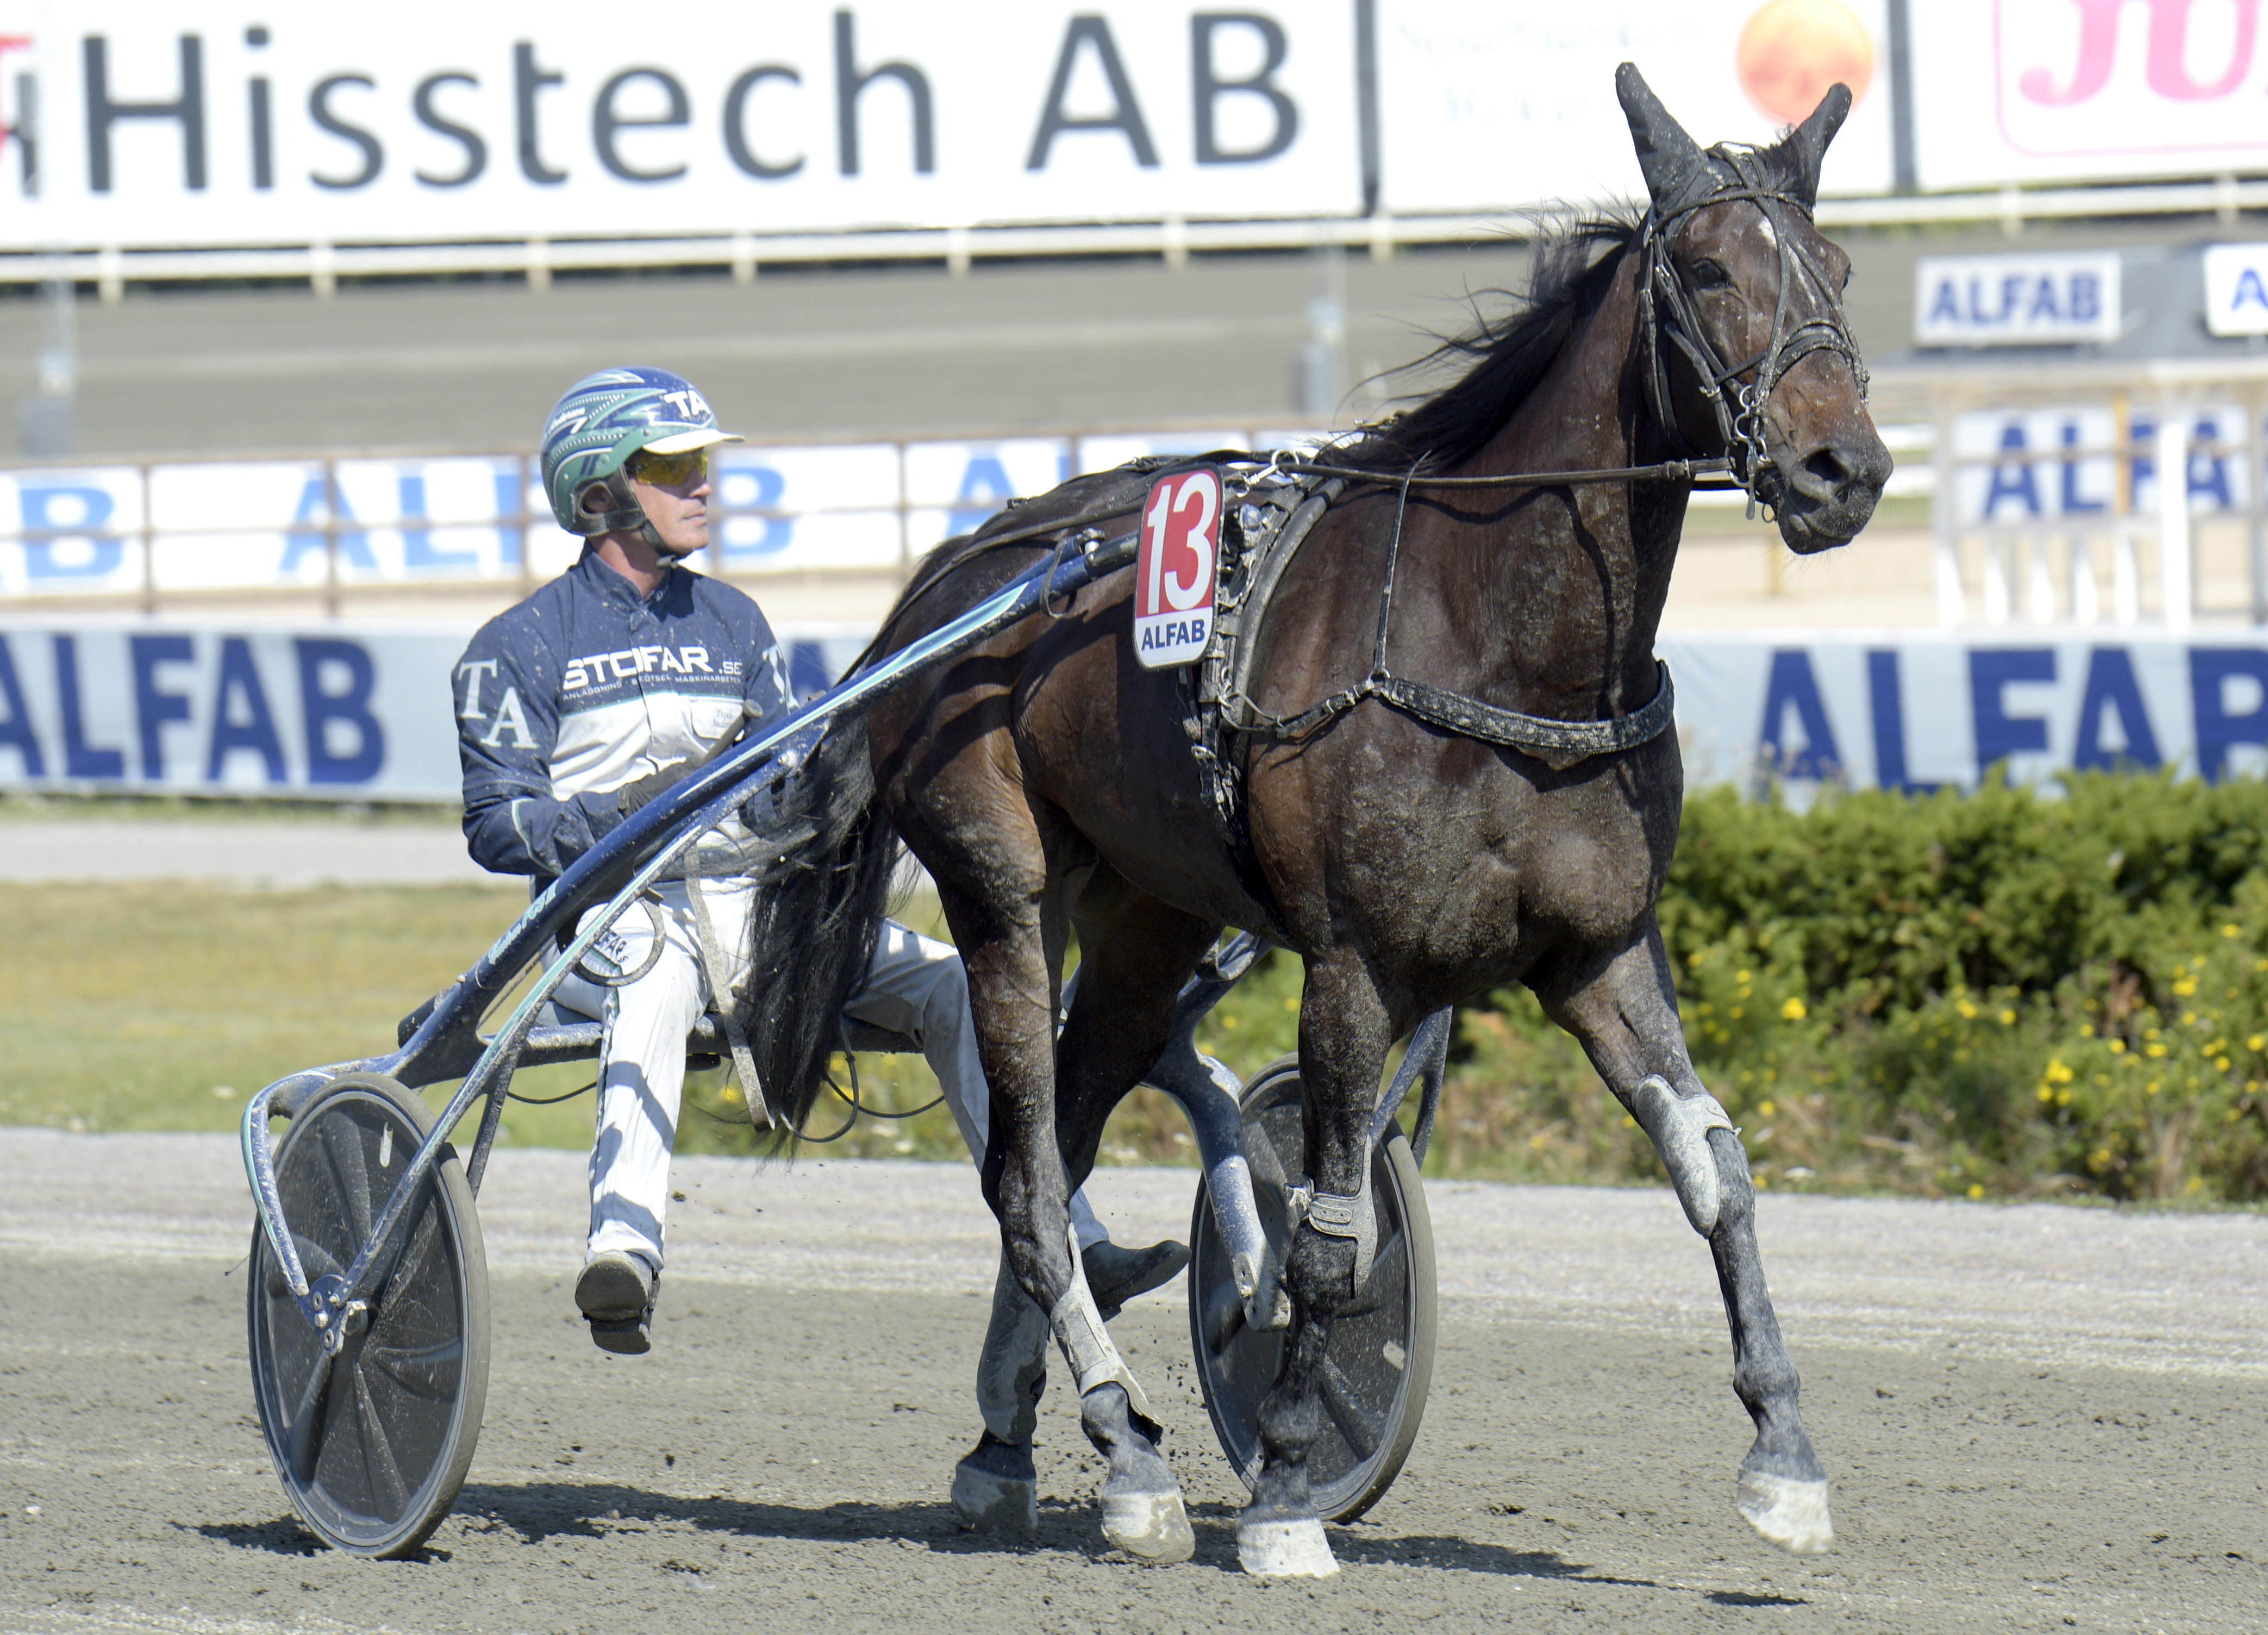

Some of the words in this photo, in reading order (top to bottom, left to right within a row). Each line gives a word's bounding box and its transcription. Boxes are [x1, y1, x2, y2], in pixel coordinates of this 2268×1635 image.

[82, 8, 937, 192] Hisstech
[1024, 11, 1300, 170] AB
[2019, 0, 2268, 106] JU
[1929, 273, 2101, 325] ALFAB
[664, 390, 711, 417] TA
[1983, 421, 2268, 516] ALFA
[1147, 472, 1217, 615] 13
[1141, 619, 1205, 651] ALFAB
